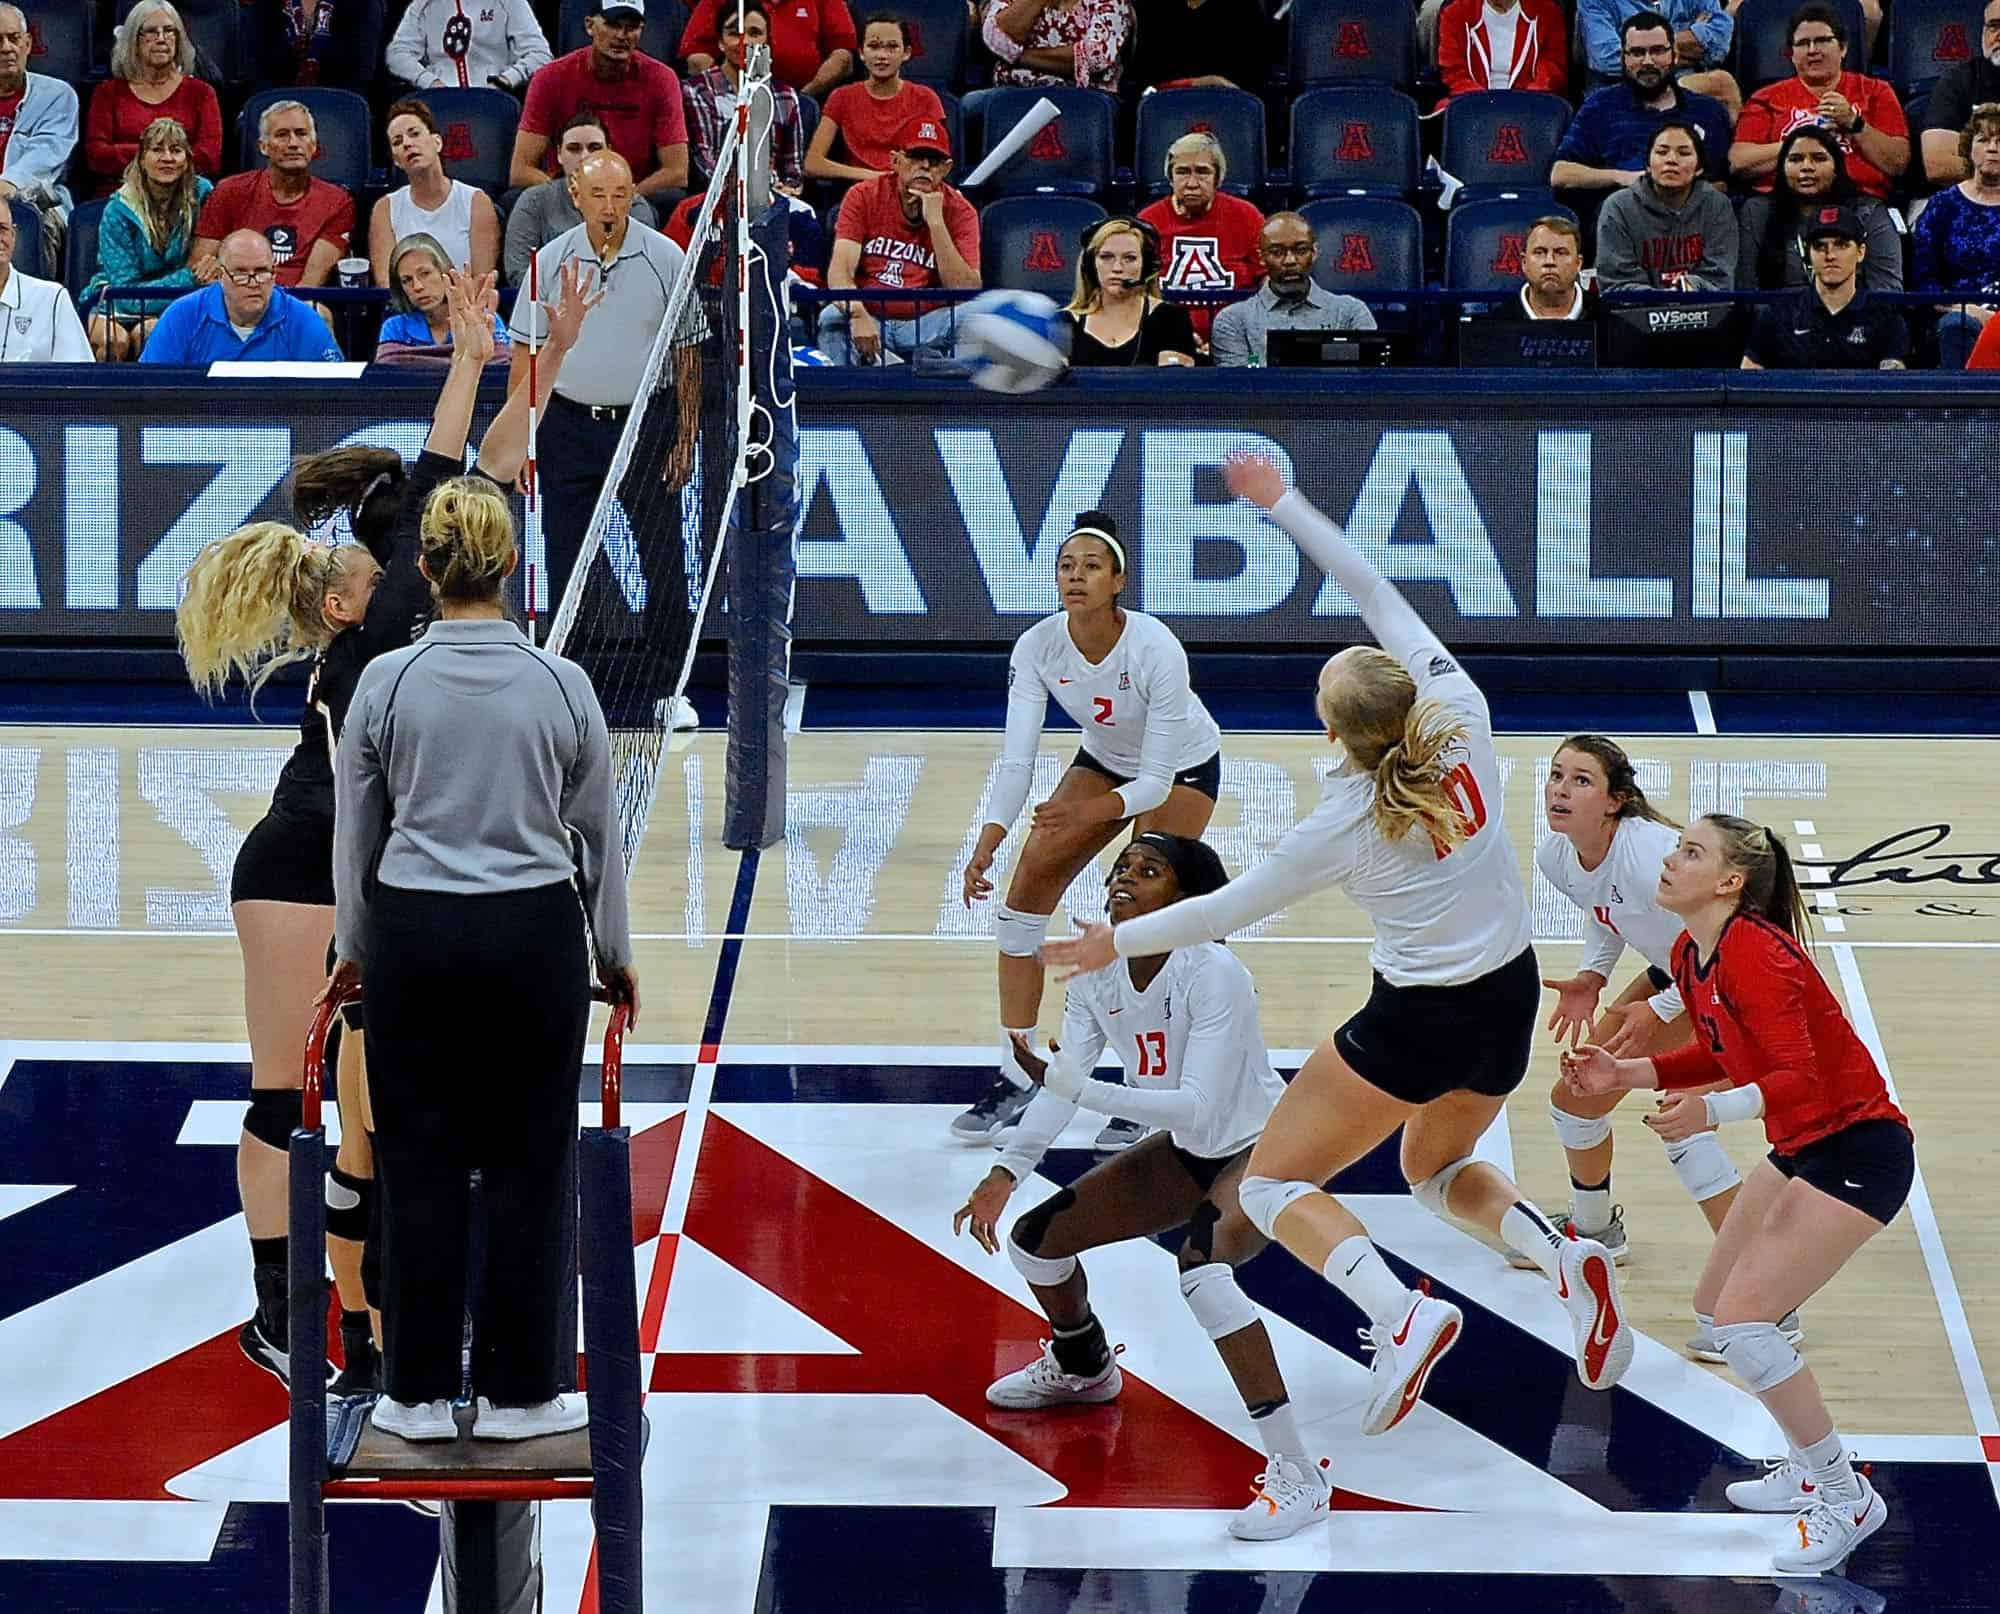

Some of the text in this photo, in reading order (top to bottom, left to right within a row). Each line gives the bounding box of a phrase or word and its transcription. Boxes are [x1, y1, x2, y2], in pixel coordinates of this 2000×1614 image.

[1332, 21, 1371, 59] A
[1934, 22, 1971, 61] A
[1028, 122, 1067, 160] A
[1333, 121, 1376, 162] A
[1487, 122, 1529, 164] A
[863, 236, 935, 269] ARIZONA
[1023, 231, 1067, 272] A
[1159, 235, 1234, 291] A
[1335, 232, 1376, 275] A
[1490, 233, 1525, 275] A
[875, 259, 904, 288] A
[1092, 697, 1117, 727] 2
[1133, 1030, 1169, 1078] 13
